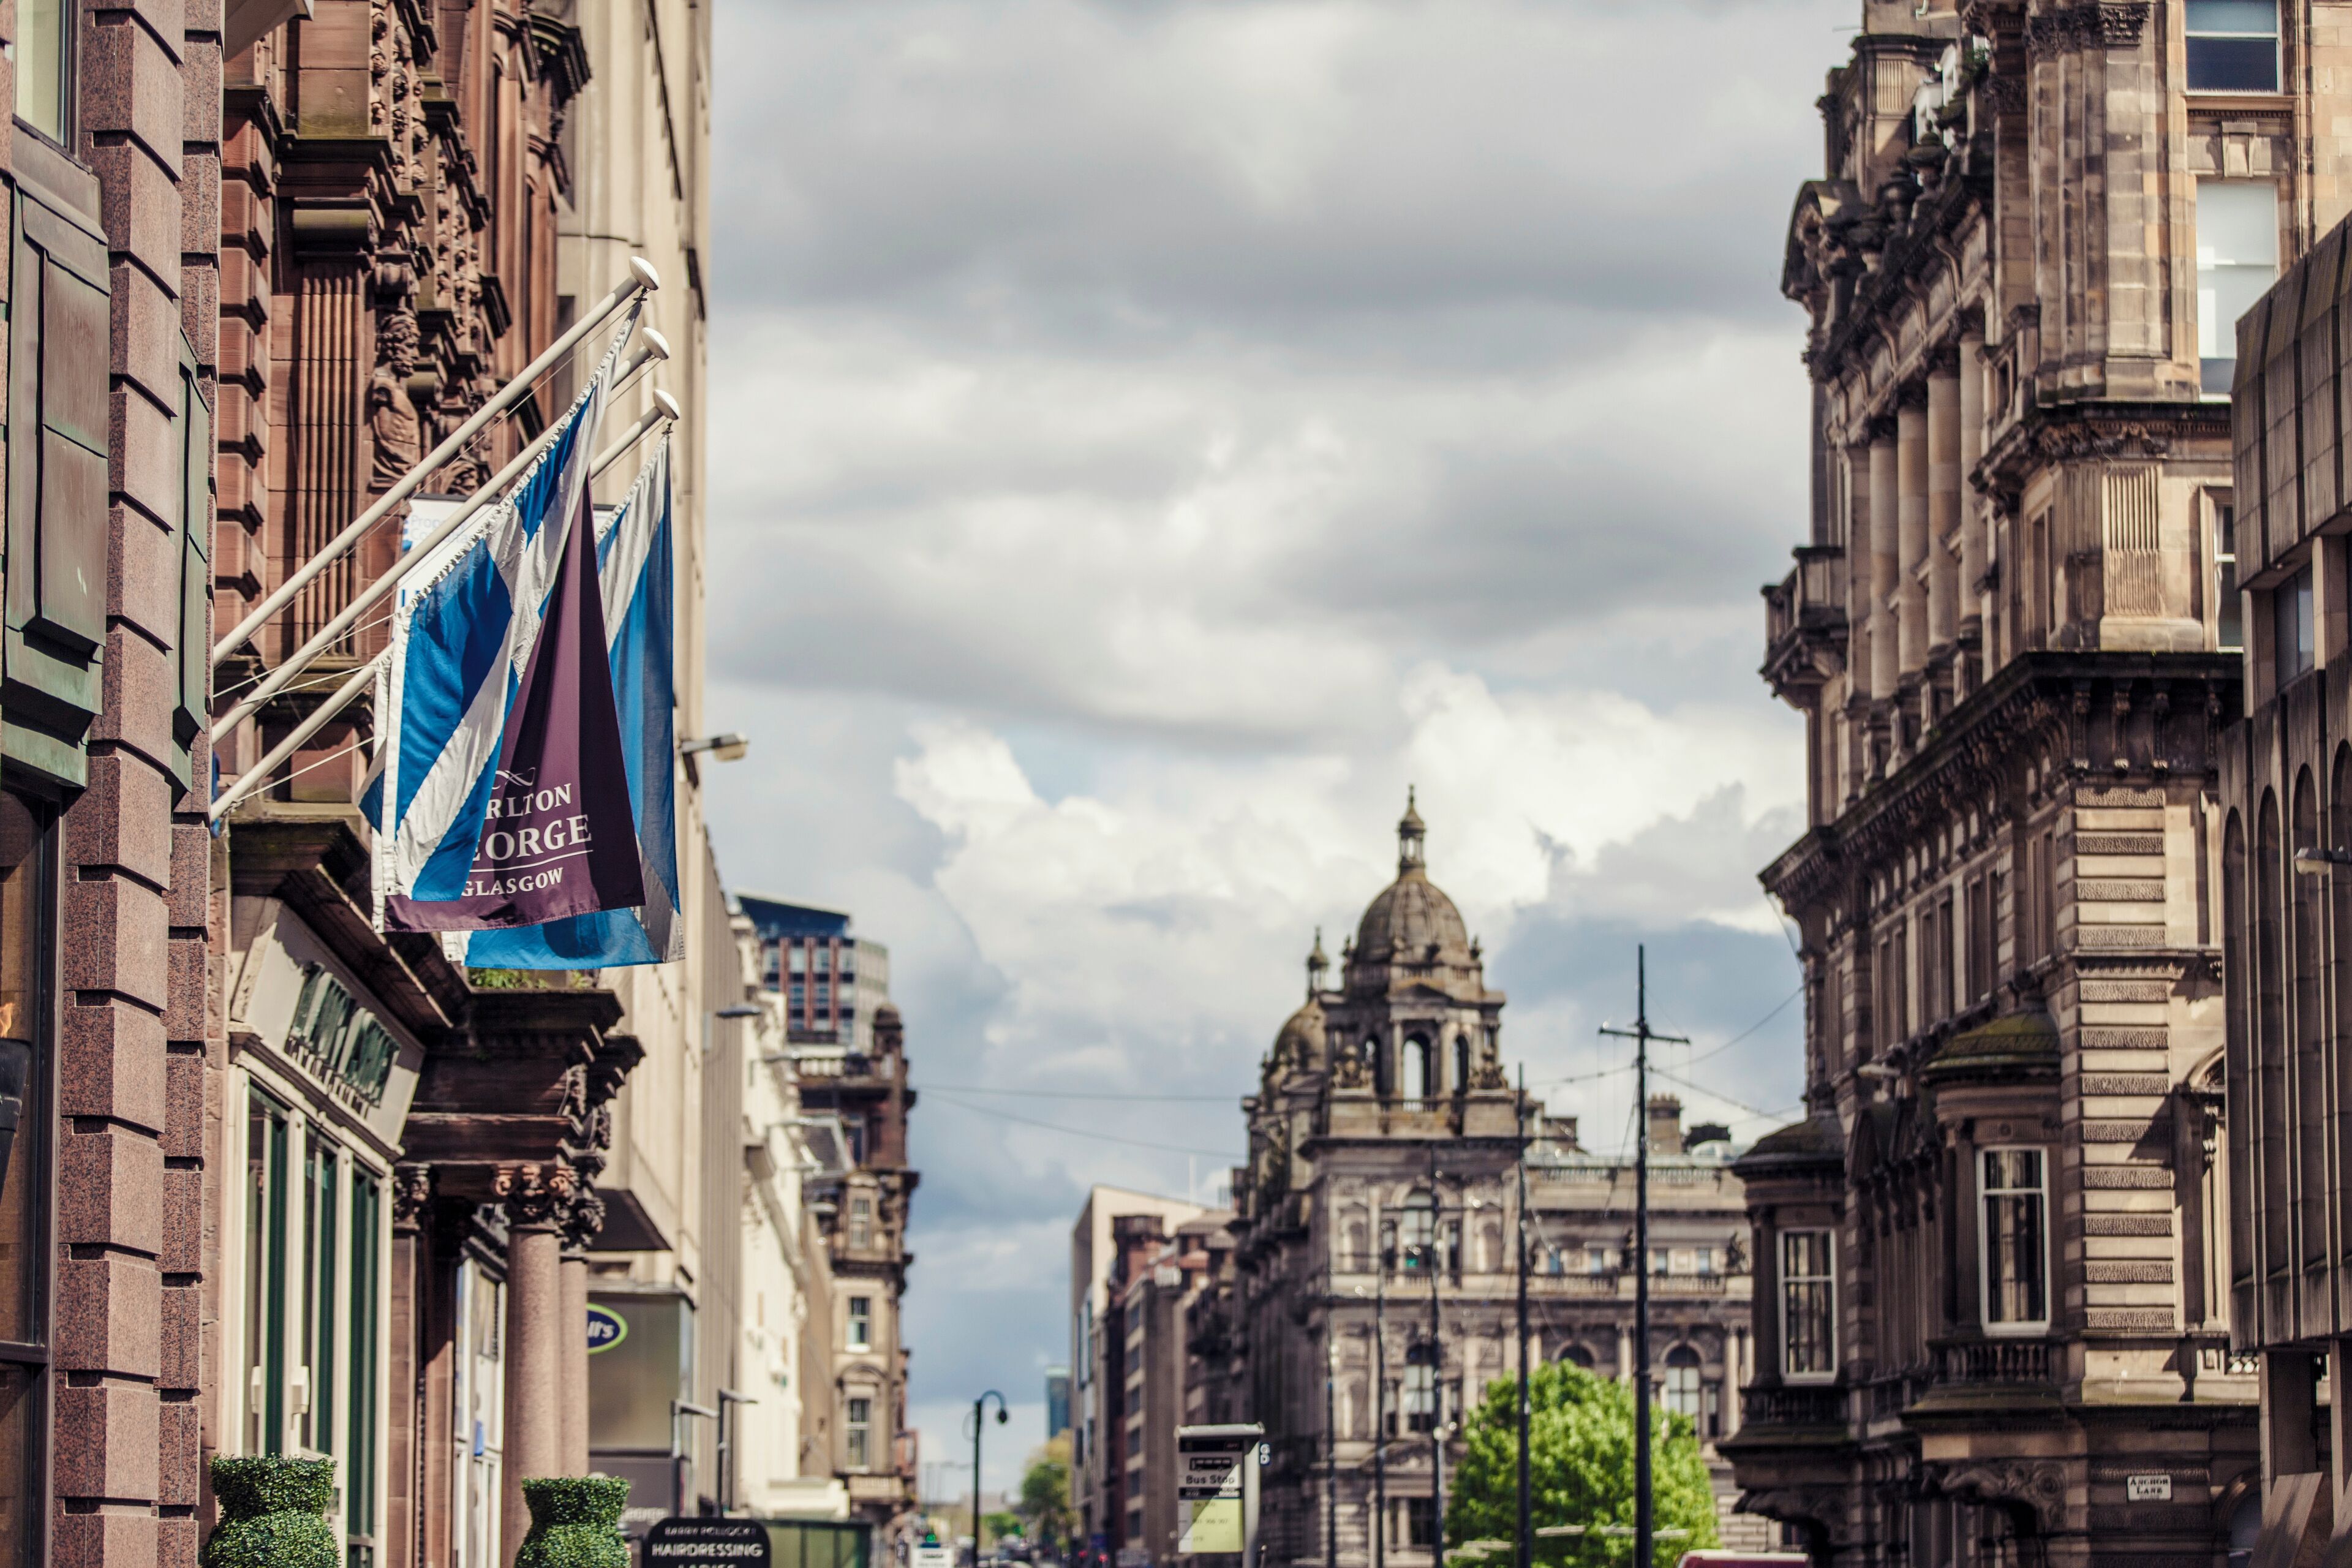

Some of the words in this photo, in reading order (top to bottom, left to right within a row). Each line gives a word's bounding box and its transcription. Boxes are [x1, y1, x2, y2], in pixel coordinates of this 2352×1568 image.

[484, 783, 571, 820] RLTON
[472, 814, 592, 861] ORGE
[461, 867, 564, 897] GLASGOW
[1185, 1476, 1206, 1484] Bus
[1209, 1474, 1235, 1485] Stop
[652, 1543, 764, 1557] HAIRDRESSING
